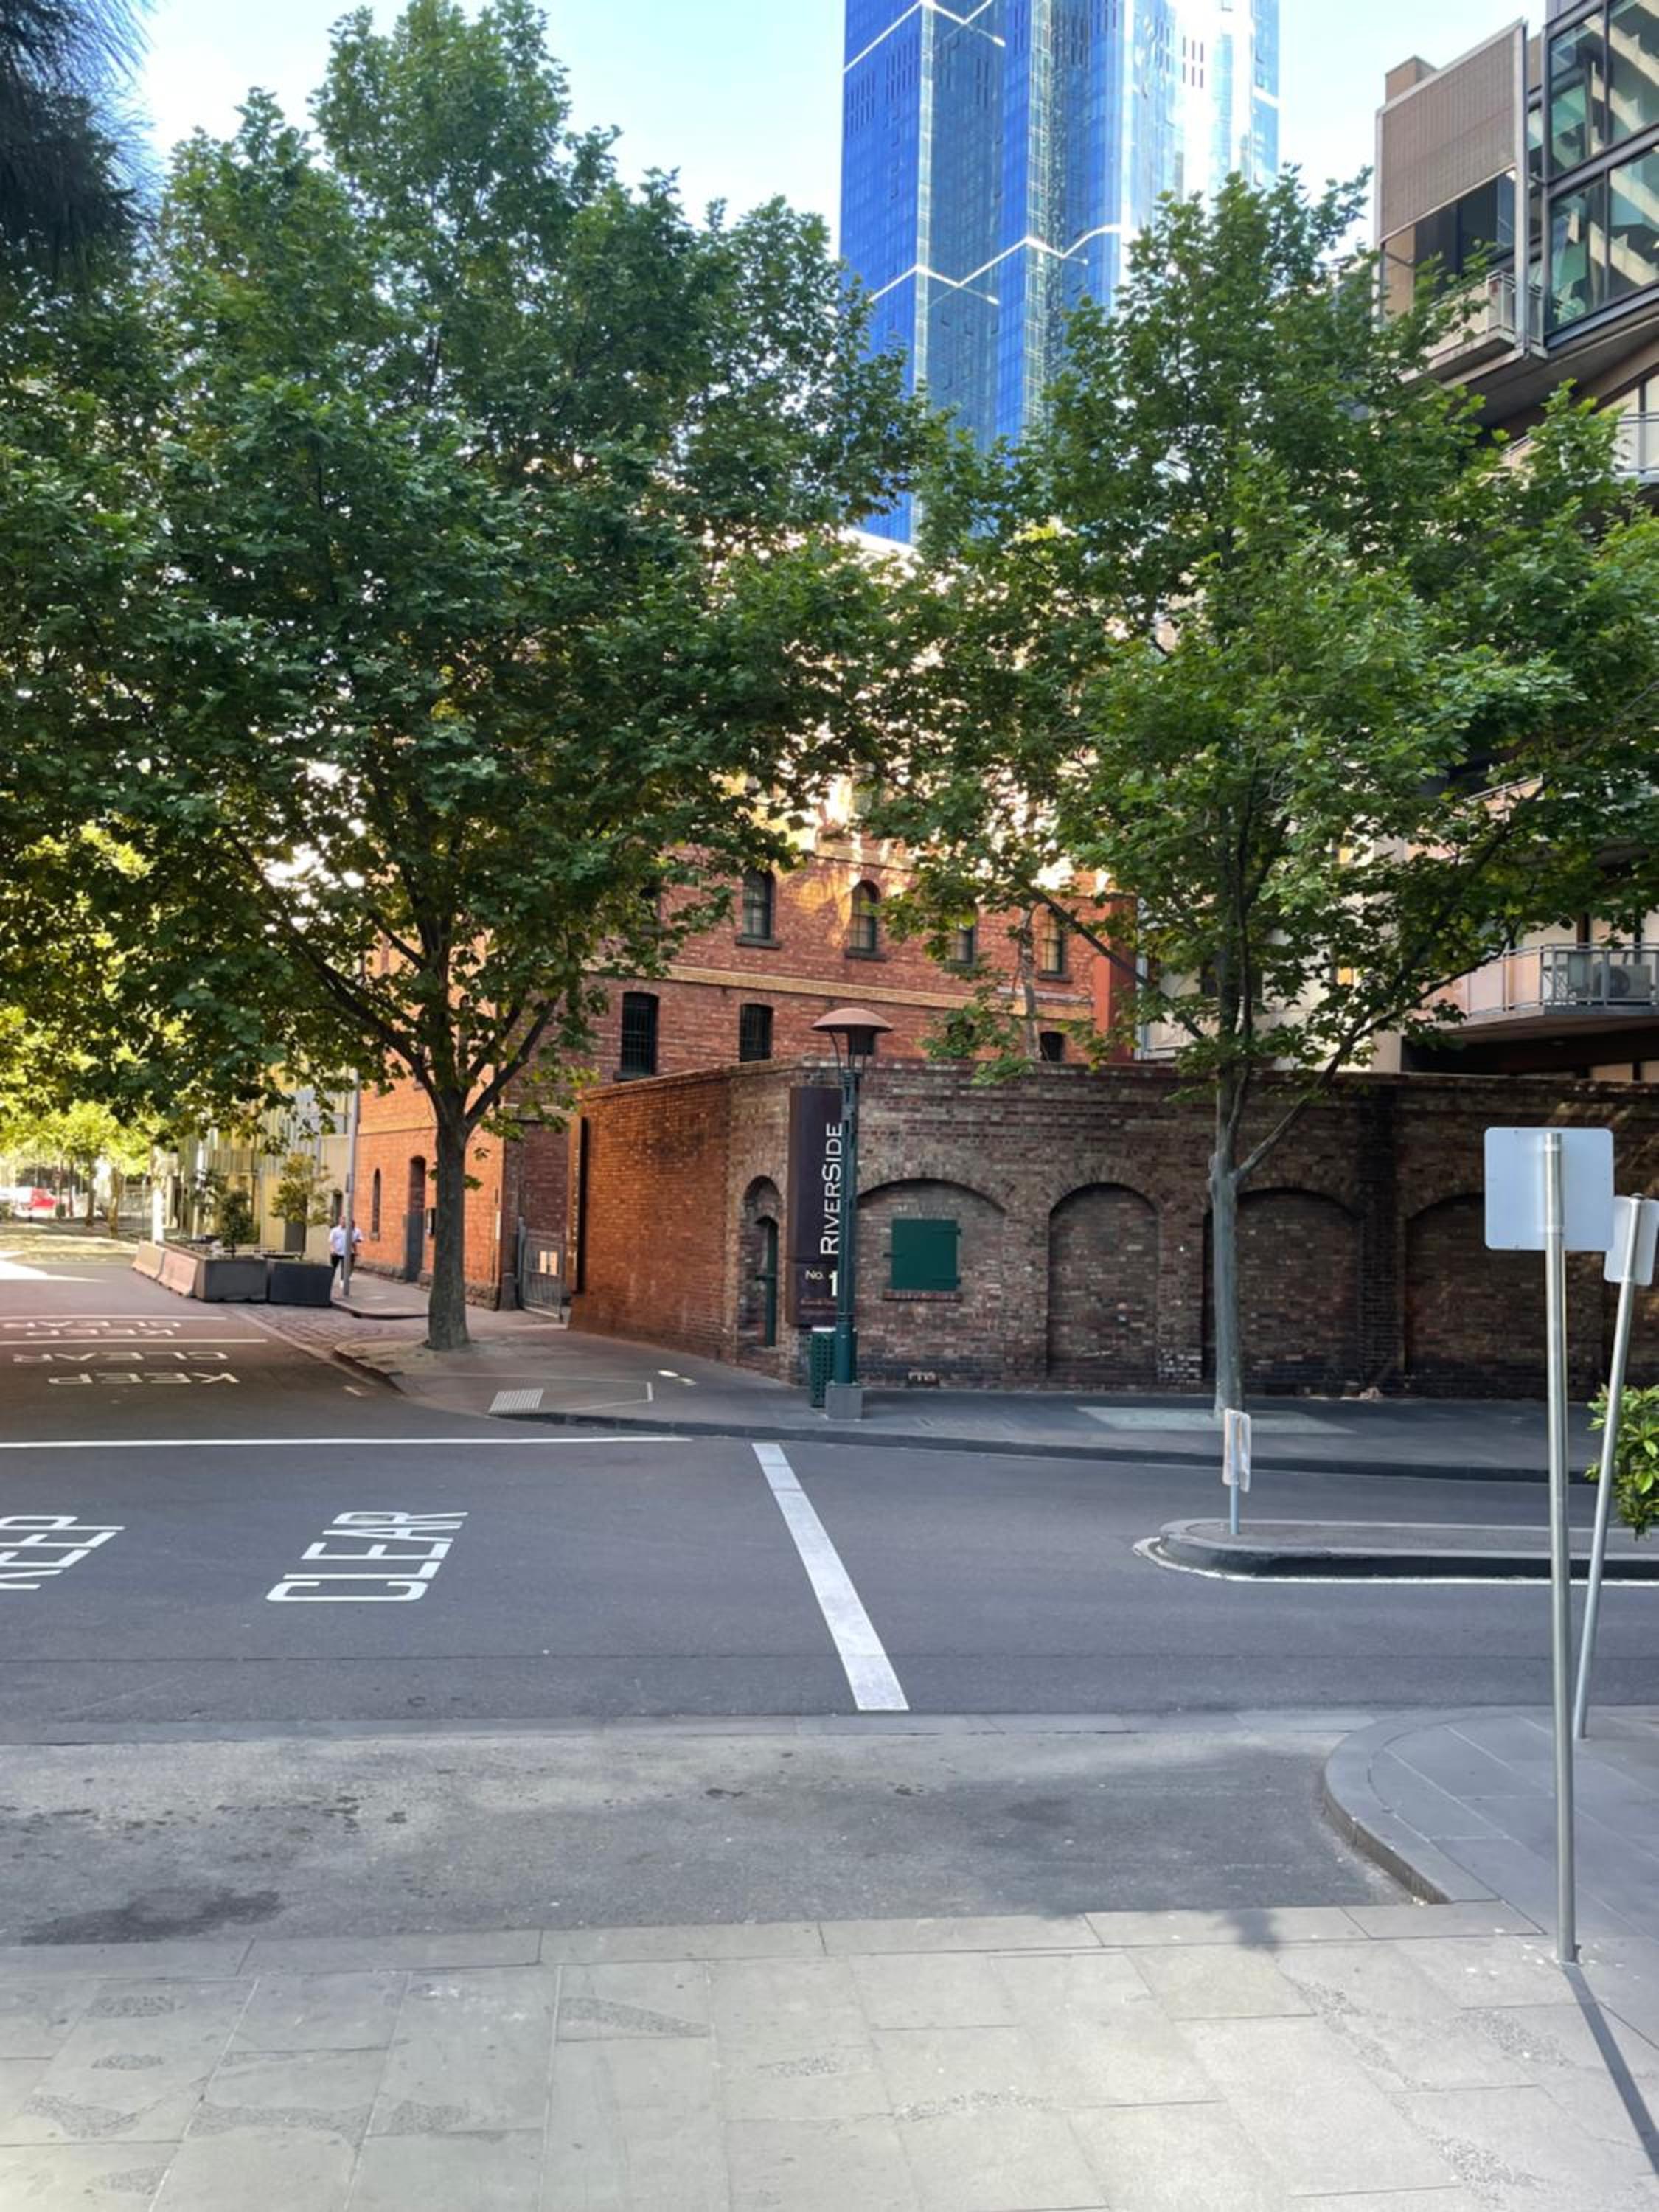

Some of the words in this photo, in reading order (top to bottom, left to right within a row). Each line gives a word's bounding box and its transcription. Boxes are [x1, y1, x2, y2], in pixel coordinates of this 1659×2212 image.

[820, 1122, 842, 1255] RIVERSIDE
[829, 1270, 838, 1297] 1
[13, 1352, 229, 1363] CLEAR
[48, 1372, 240, 1384] KEEP
[265, 1511, 468, 1601] CLEAR
